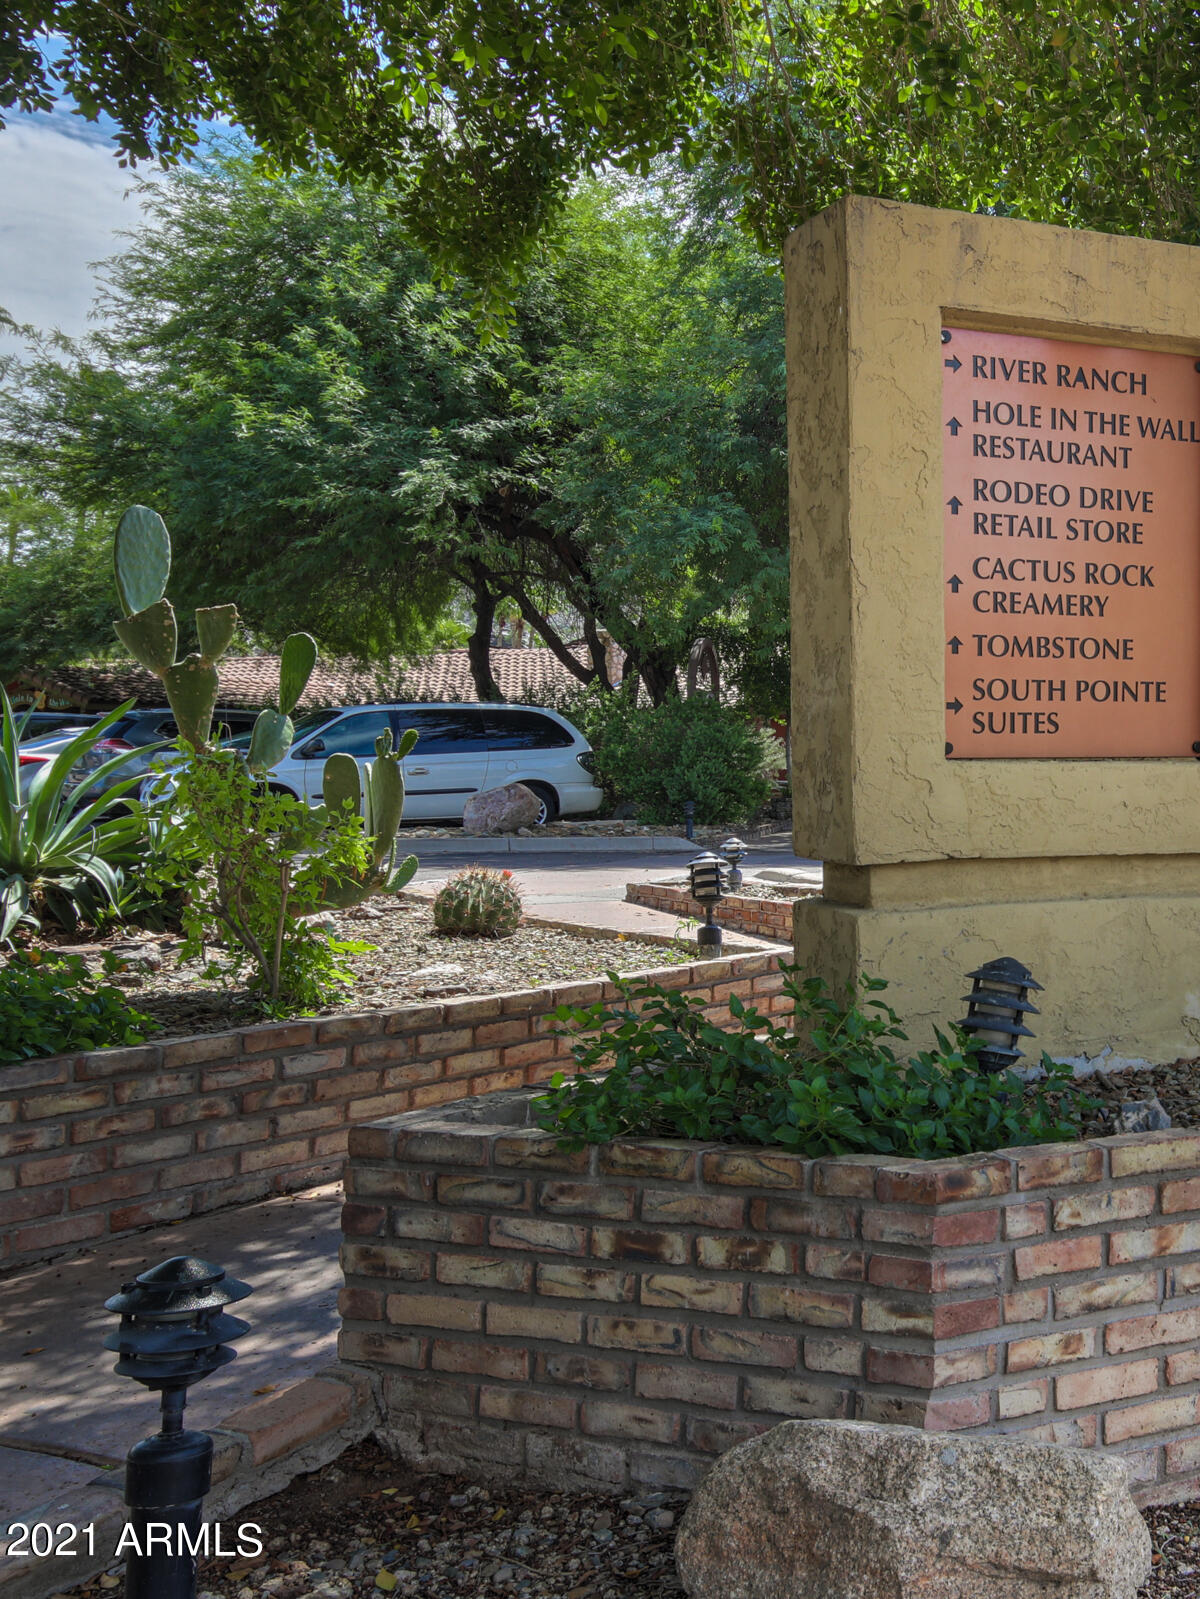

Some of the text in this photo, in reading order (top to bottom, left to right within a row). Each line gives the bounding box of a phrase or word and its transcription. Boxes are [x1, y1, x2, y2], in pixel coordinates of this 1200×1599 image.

[973, 354, 1147, 396] RIVER RANCH
[972, 400, 1200, 443] HOLE IN THE WALL
[973, 434, 1132, 469] RESTAURANT
[973, 478, 1154, 513] RODEO DRIVE
[973, 512, 1144, 545] RETAIL STORE
[972, 556, 1155, 588] CACTUS ROCK
[972, 590, 1109, 617] CREAMERY
[972, 634, 1134, 661] TOMBSTONE
[972, 677, 1167, 703] SOUTH POINTE
[972, 711, 1060, 735] SUITES
